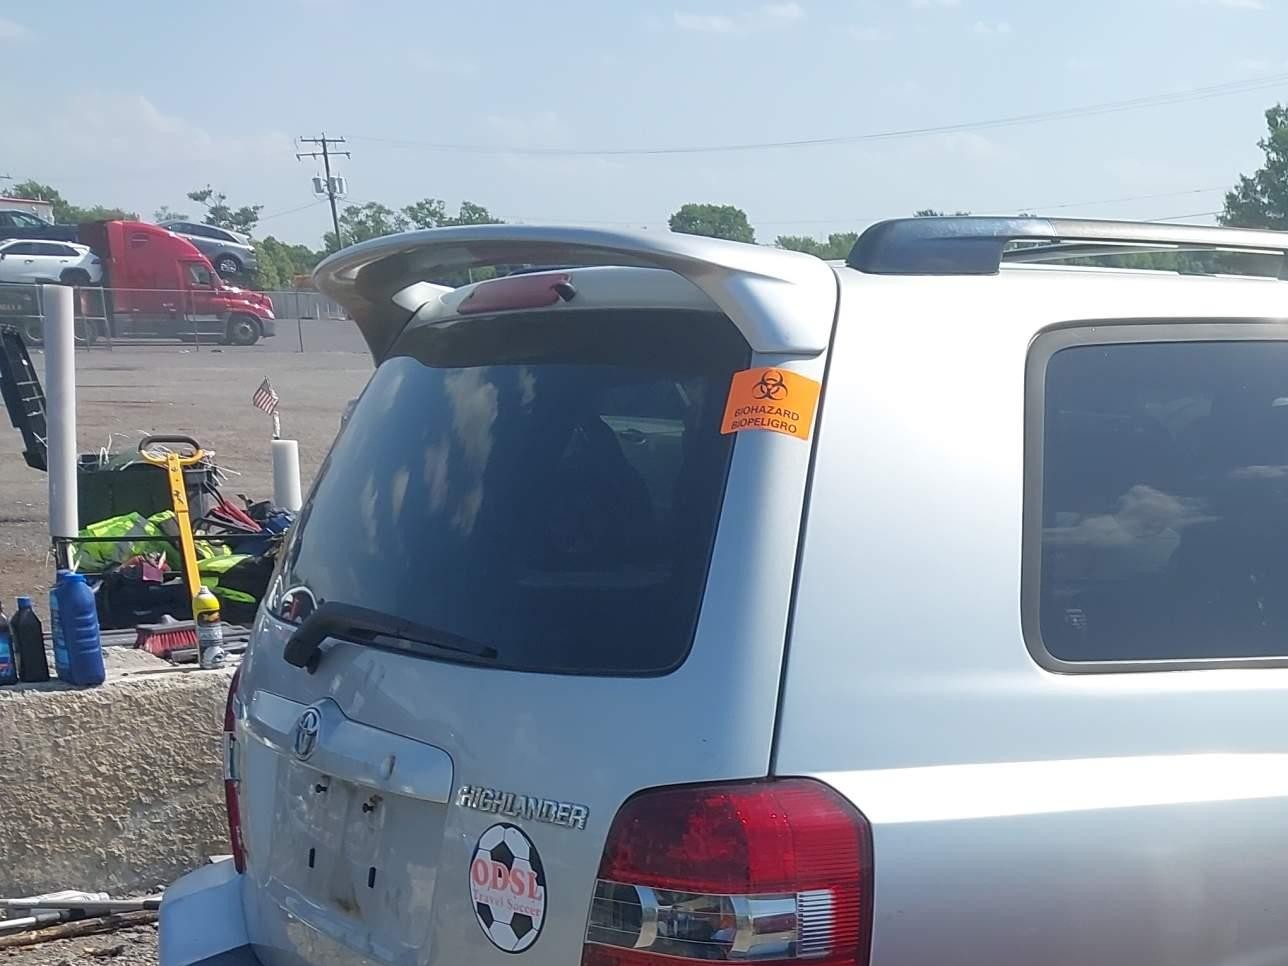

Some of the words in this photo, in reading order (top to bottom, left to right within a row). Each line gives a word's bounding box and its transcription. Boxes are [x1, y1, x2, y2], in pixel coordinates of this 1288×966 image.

[731, 417, 798, 434] BIOPELIGRO
[734, 405, 800, 421] BIOHAZARD
[456, 784, 590, 831] HIGHLANDER
[472, 858, 543, 902] ODSL
[473, 889, 505, 907] Travel
[507, 897, 542, 918] Soccer
